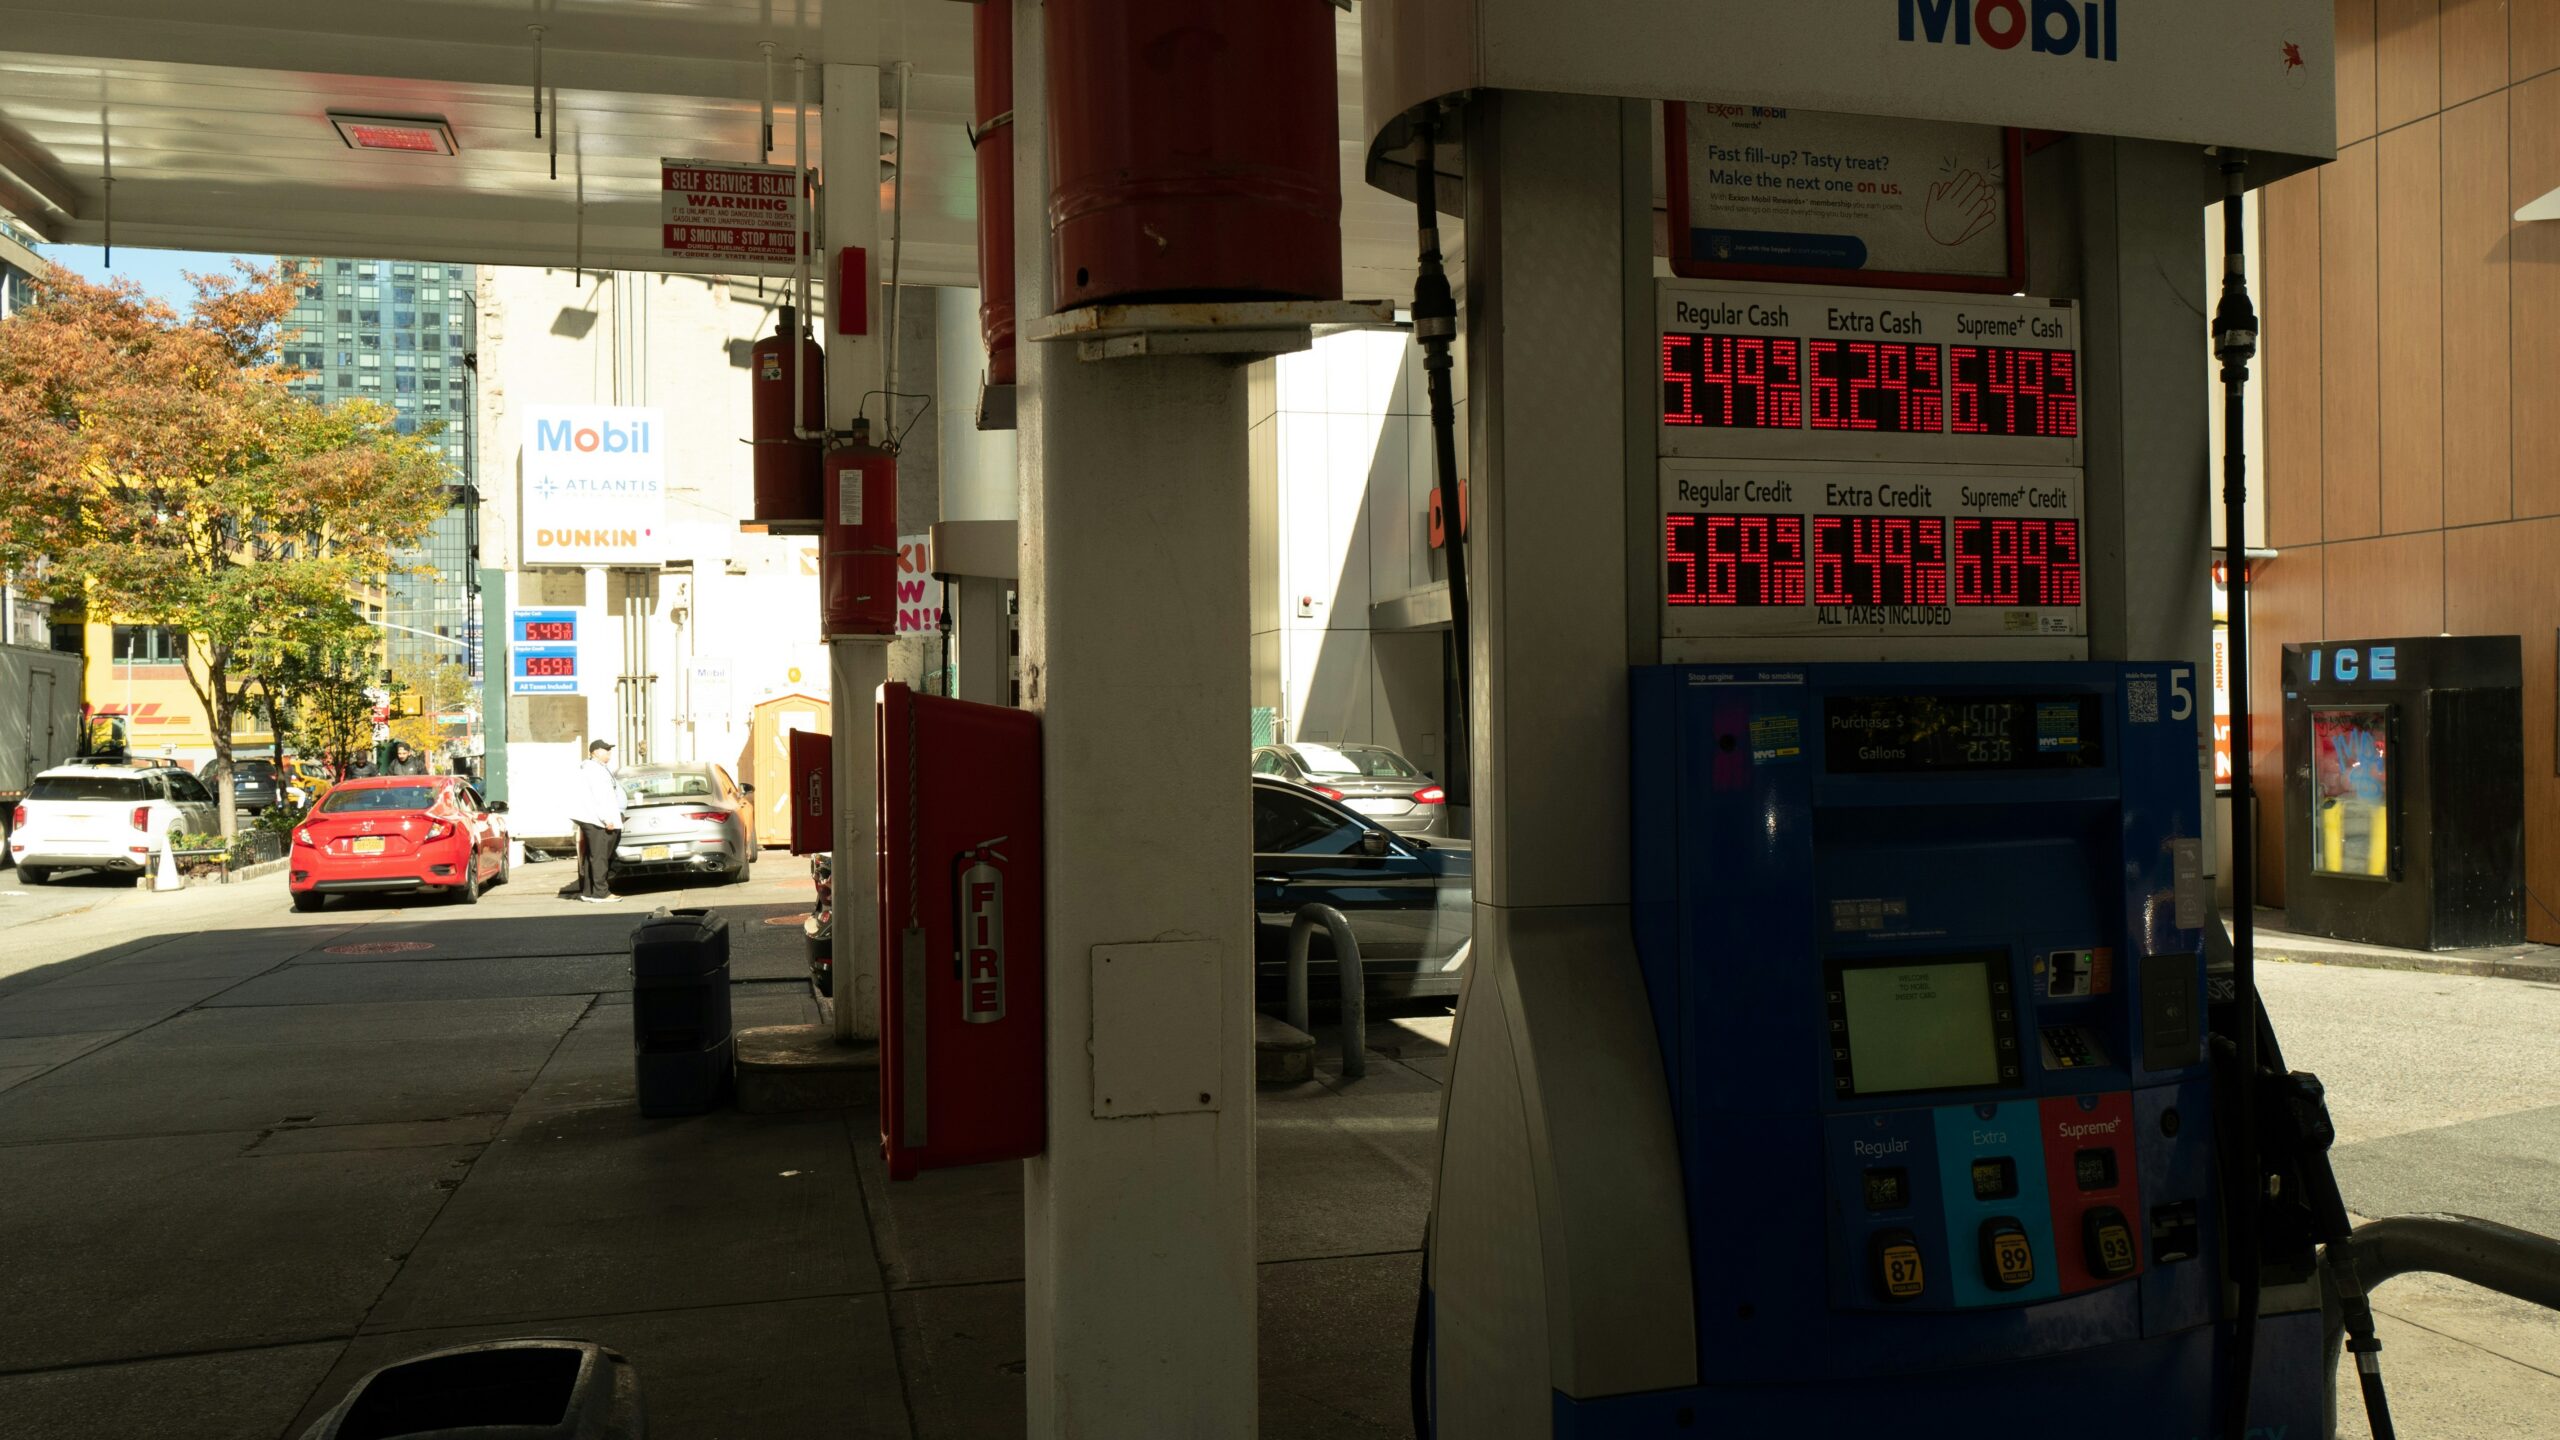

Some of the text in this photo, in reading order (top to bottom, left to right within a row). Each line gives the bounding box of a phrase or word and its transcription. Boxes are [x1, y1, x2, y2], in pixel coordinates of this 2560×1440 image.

[1898, 0, 2117, 61] Mobil
[1752, 106, 1786, 118] Mobil
[1708, 145, 1889, 172] Fast fill-up? Tasty treat?
[672, 171, 796, 196] SELF SERVICE ISLAN
[1709, 170, 1902, 195] Make the next one on us.
[686, 194, 788, 211] WARNING
[1728, 193, 1750, 202] Exxon
[1752, 194, 1771, 204] Mobil
[1810, 199, 1851, 208] membership
[686, 208, 716, 216] UNLAWFUL
[730, 210, 764, 218] DANGEROUS
[718, 218, 755, 226] UNAPPROVED
[757, 220, 792, 228] CONTAINERS
[673, 228, 796, 247] NO SMOKING STOP MOTO
[748, 246, 787, 254] OPERATION
[1677, 302, 1742, 330] Regular
[1748, 305, 1790, 327] Cash
[1828, 308, 1874, 333] Extra
[1880, 310, 1922, 334] Cash
[2032, 318, 2062, 338] Cash
[1663, 336, 1765, 426] 5.49
[1810, 342, 1908, 430] 6.29
[1951, 348, 2044, 434] 6.49
[537, 418, 650, 453] Mobil
[566, 478, 657, 492] ATLANTIS
[1678, 480, 1739, 508] Regular
[1744, 480, 1792, 503] Credit
[1826, 484, 1872, 507] Extra
[1878, 484, 1932, 508] Credit
[2029, 488, 2067, 508] Credit
[1666, 516, 1768, 604] 5.69
[1814, 518, 1912, 604] 6.49
[1955, 520, 2048, 604] 6.89
[1818, 606, 1952, 626] ALL TAXES INCLUDED
[526, 623, 562, 640] 5.49
[528, 658, 562, 675] 5.69
[2309, 646, 2396, 682] ICE
[1758, 672, 1803, 682] No smoking
[2170, 668, 2192, 721] 5
[1832, 716, 1890, 729] Purchase
[1896, 715, 1904, 729] $
[1858, 746, 1906, 760] Gallons
[812, 779, 822, 814] FIRE
[971, 882, 998, 1012] FIRE
[1898, 973, 1929, 982] WELCOME
[1972, 1129, 2007, 1146] Extra
[1854, 1139, 1910, 1159] Regular
[2002, 1248, 2026, 1270] 89
[2104, 1240, 2128, 1258] 93
[1891, 1260, 1917, 1282] 87
